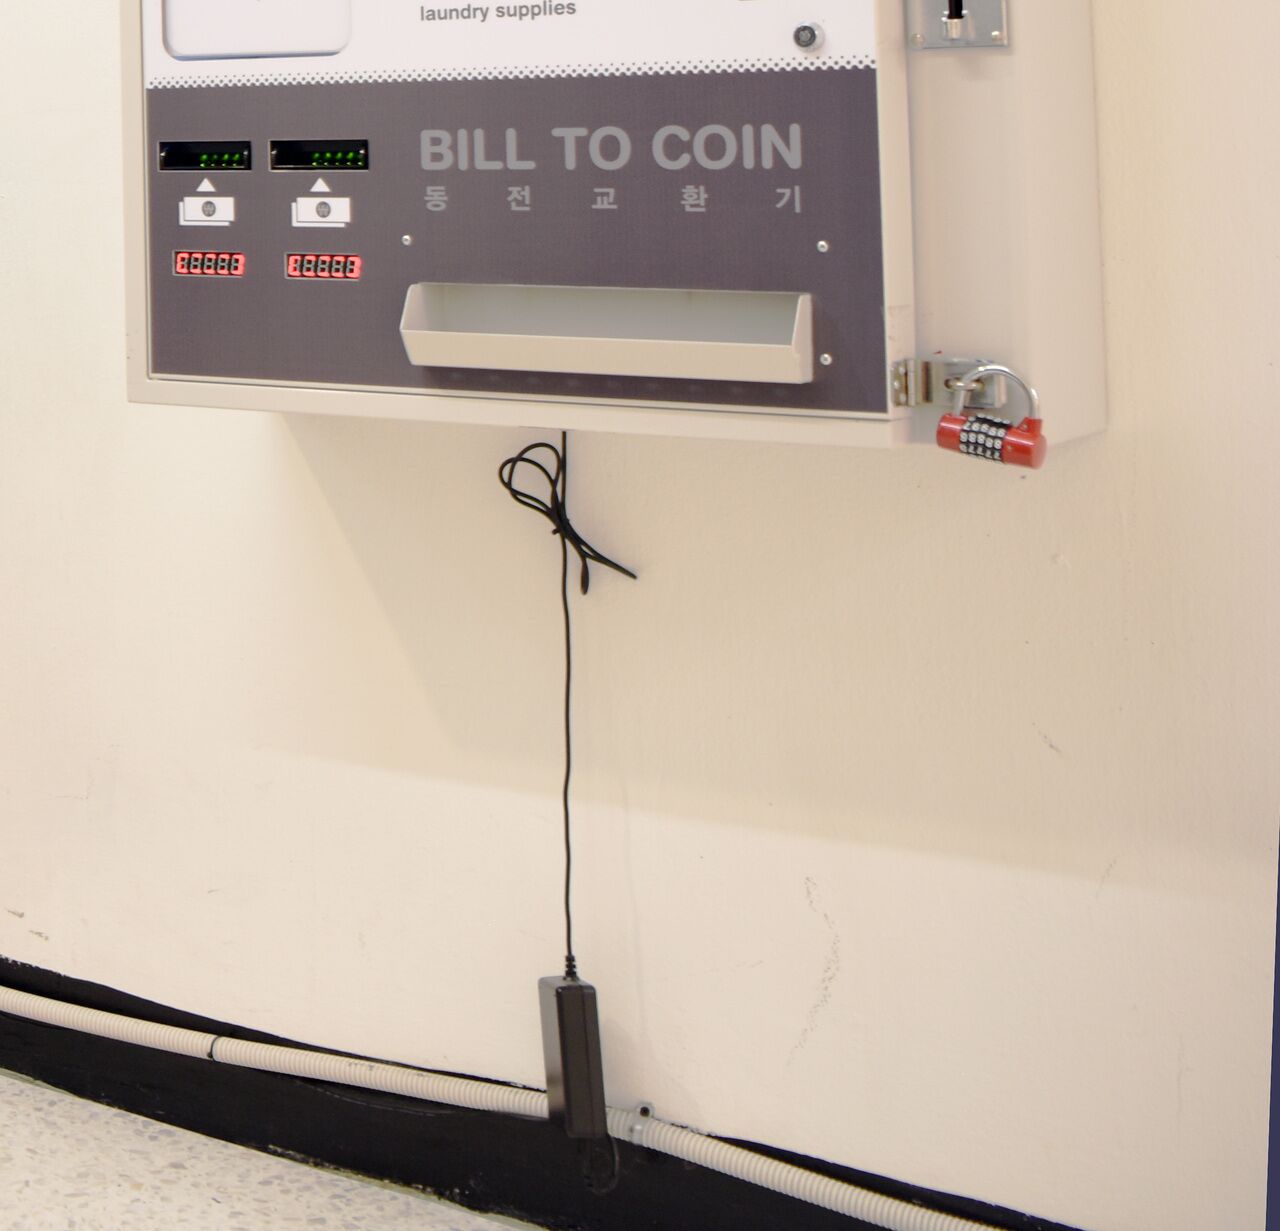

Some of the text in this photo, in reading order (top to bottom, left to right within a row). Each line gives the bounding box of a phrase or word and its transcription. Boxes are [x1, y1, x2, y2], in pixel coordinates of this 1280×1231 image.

[420, 0, 576, 24] laundry supplies
[419, 123, 803, 171] BILL TO COIN
